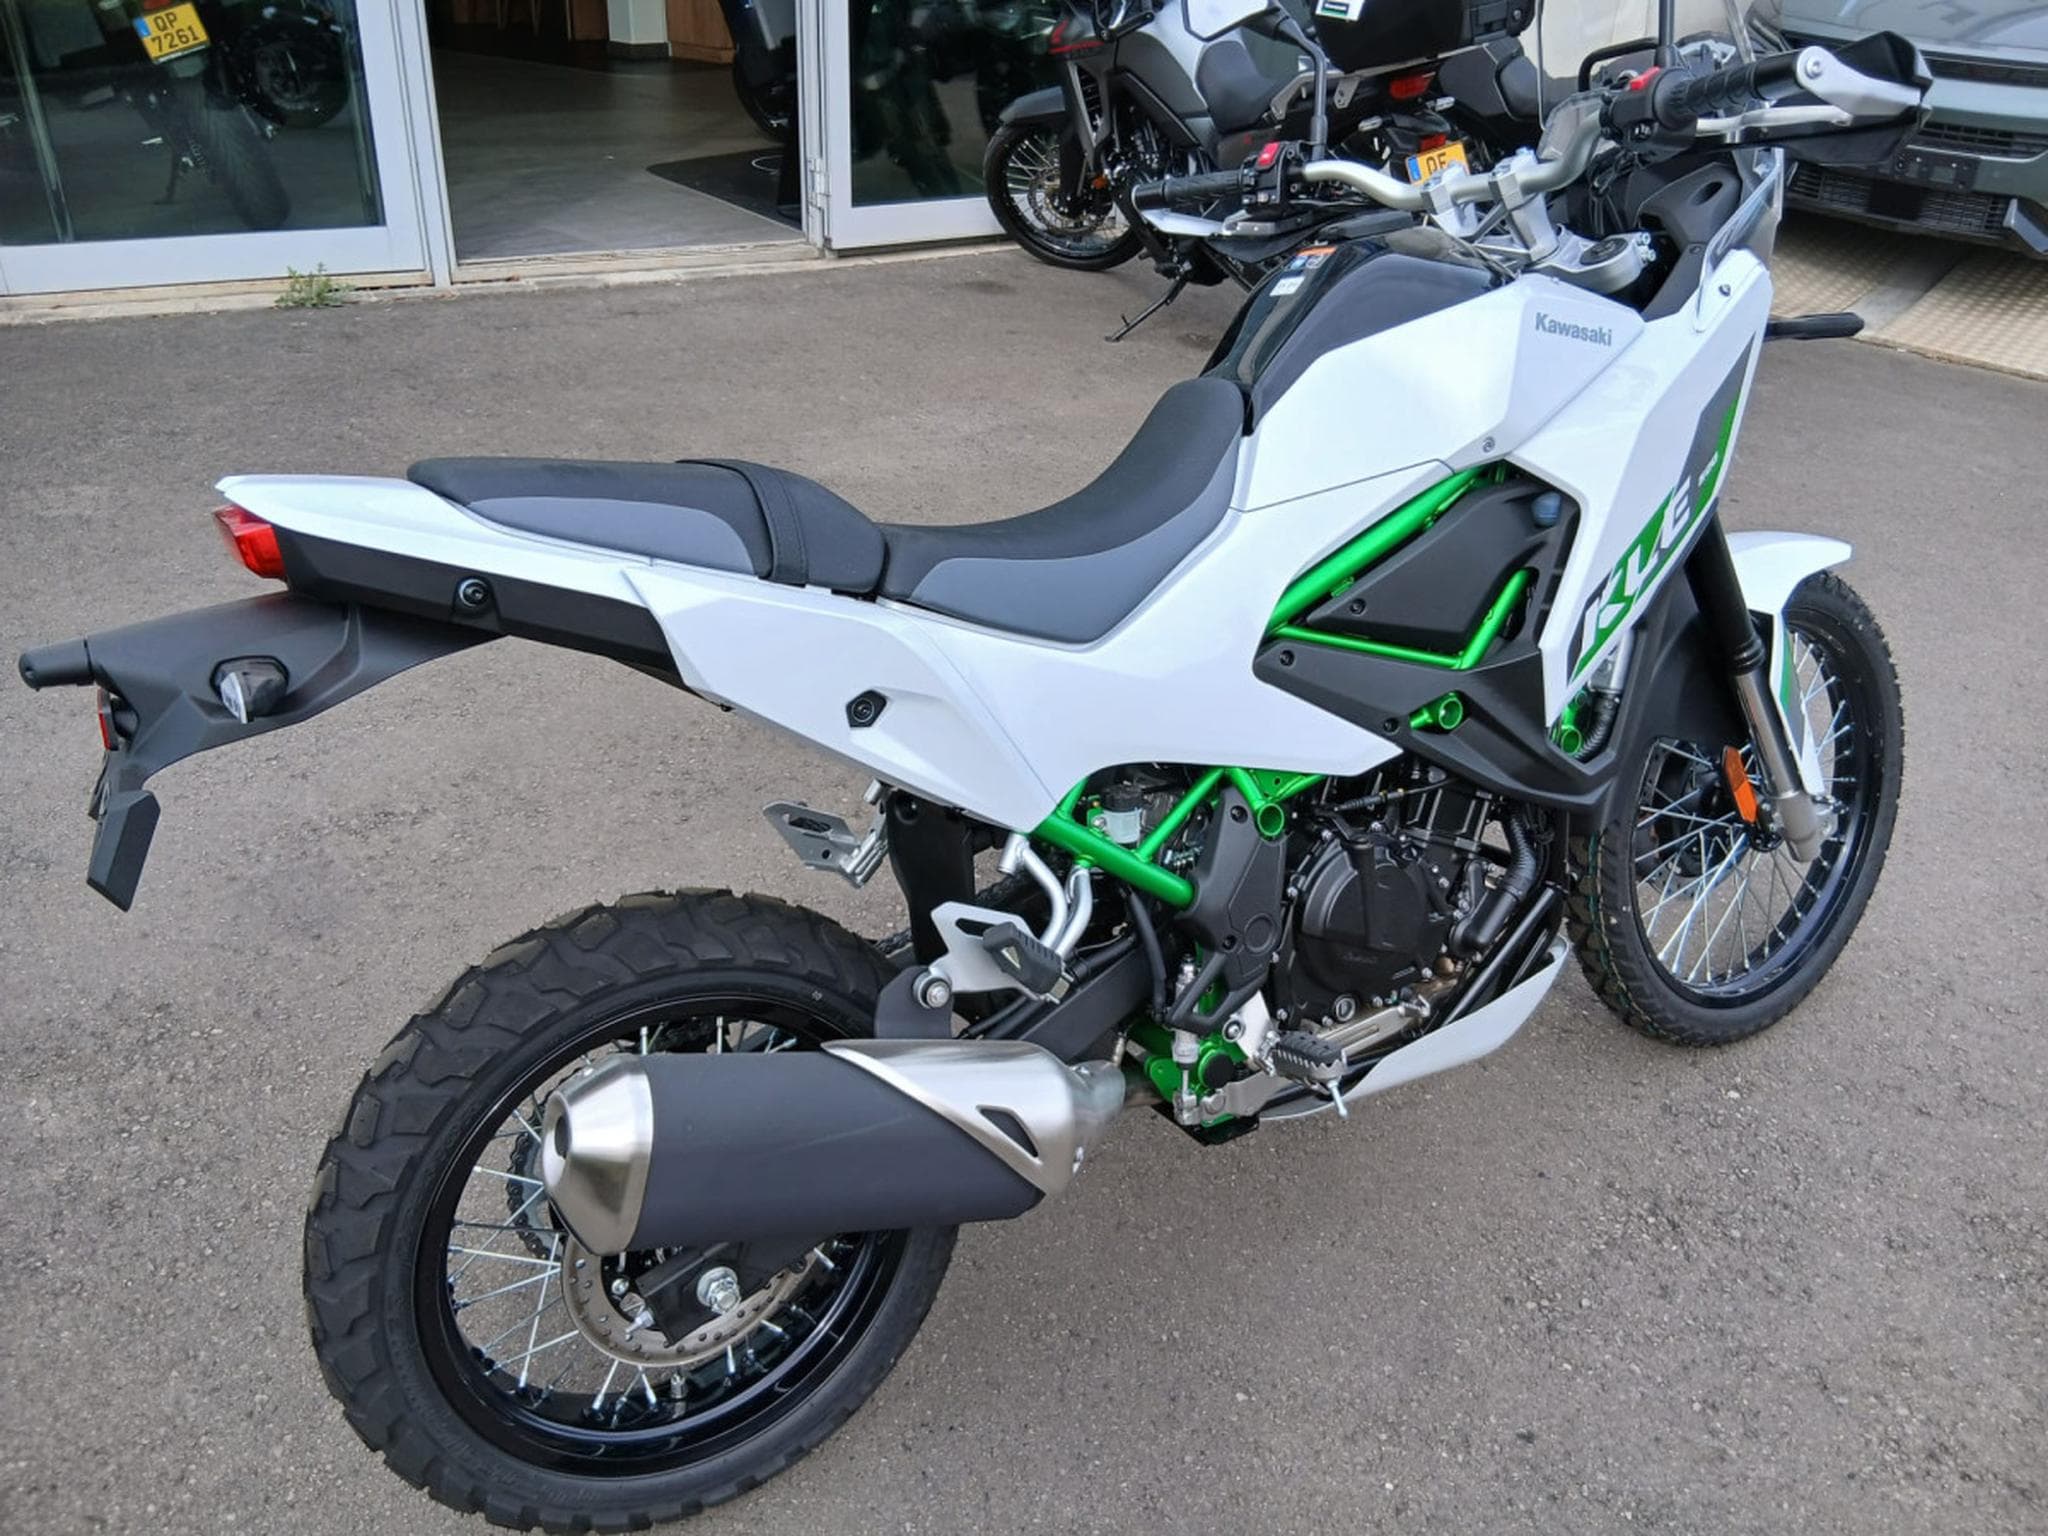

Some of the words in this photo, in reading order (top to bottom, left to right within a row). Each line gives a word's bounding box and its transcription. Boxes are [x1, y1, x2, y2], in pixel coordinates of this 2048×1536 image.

[151, 25, 200, 53] 7261
[1535, 312, 1612, 347] Kawasaki
[1582, 476, 1691, 652] KLE
